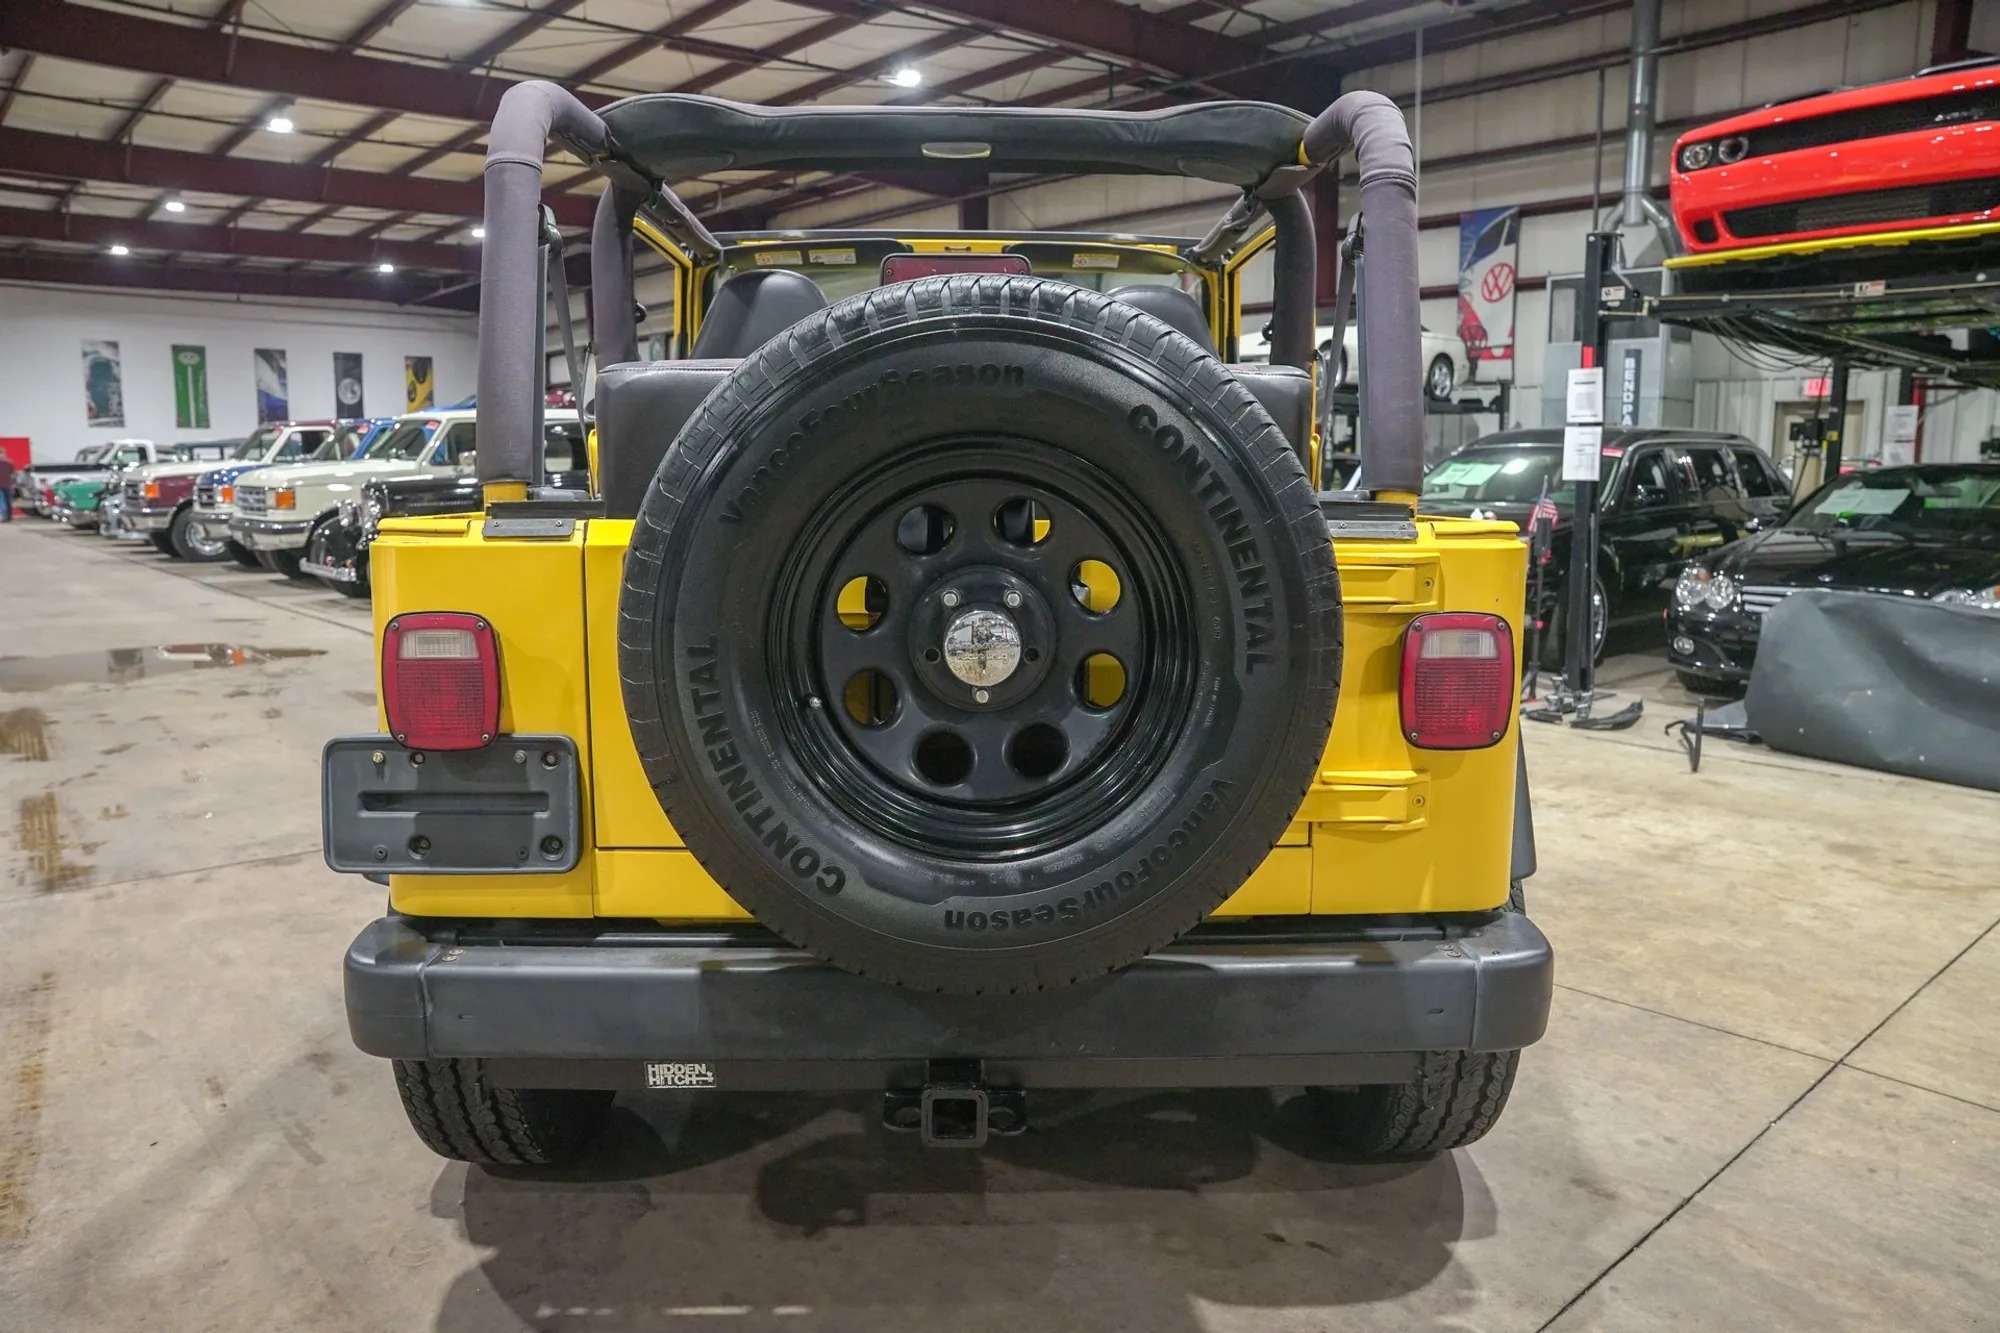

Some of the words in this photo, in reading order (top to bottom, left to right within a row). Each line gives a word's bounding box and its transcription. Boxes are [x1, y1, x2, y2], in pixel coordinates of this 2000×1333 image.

[1127, 403, 1276, 677] CONTINENTAL
[687, 633, 846, 896] CONTINENTAL
[944, 778, 1237, 933] VancoFourSeason
[647, 1063, 706, 1074] HIDDEN
[648, 1074, 697, 1085] HITCH
